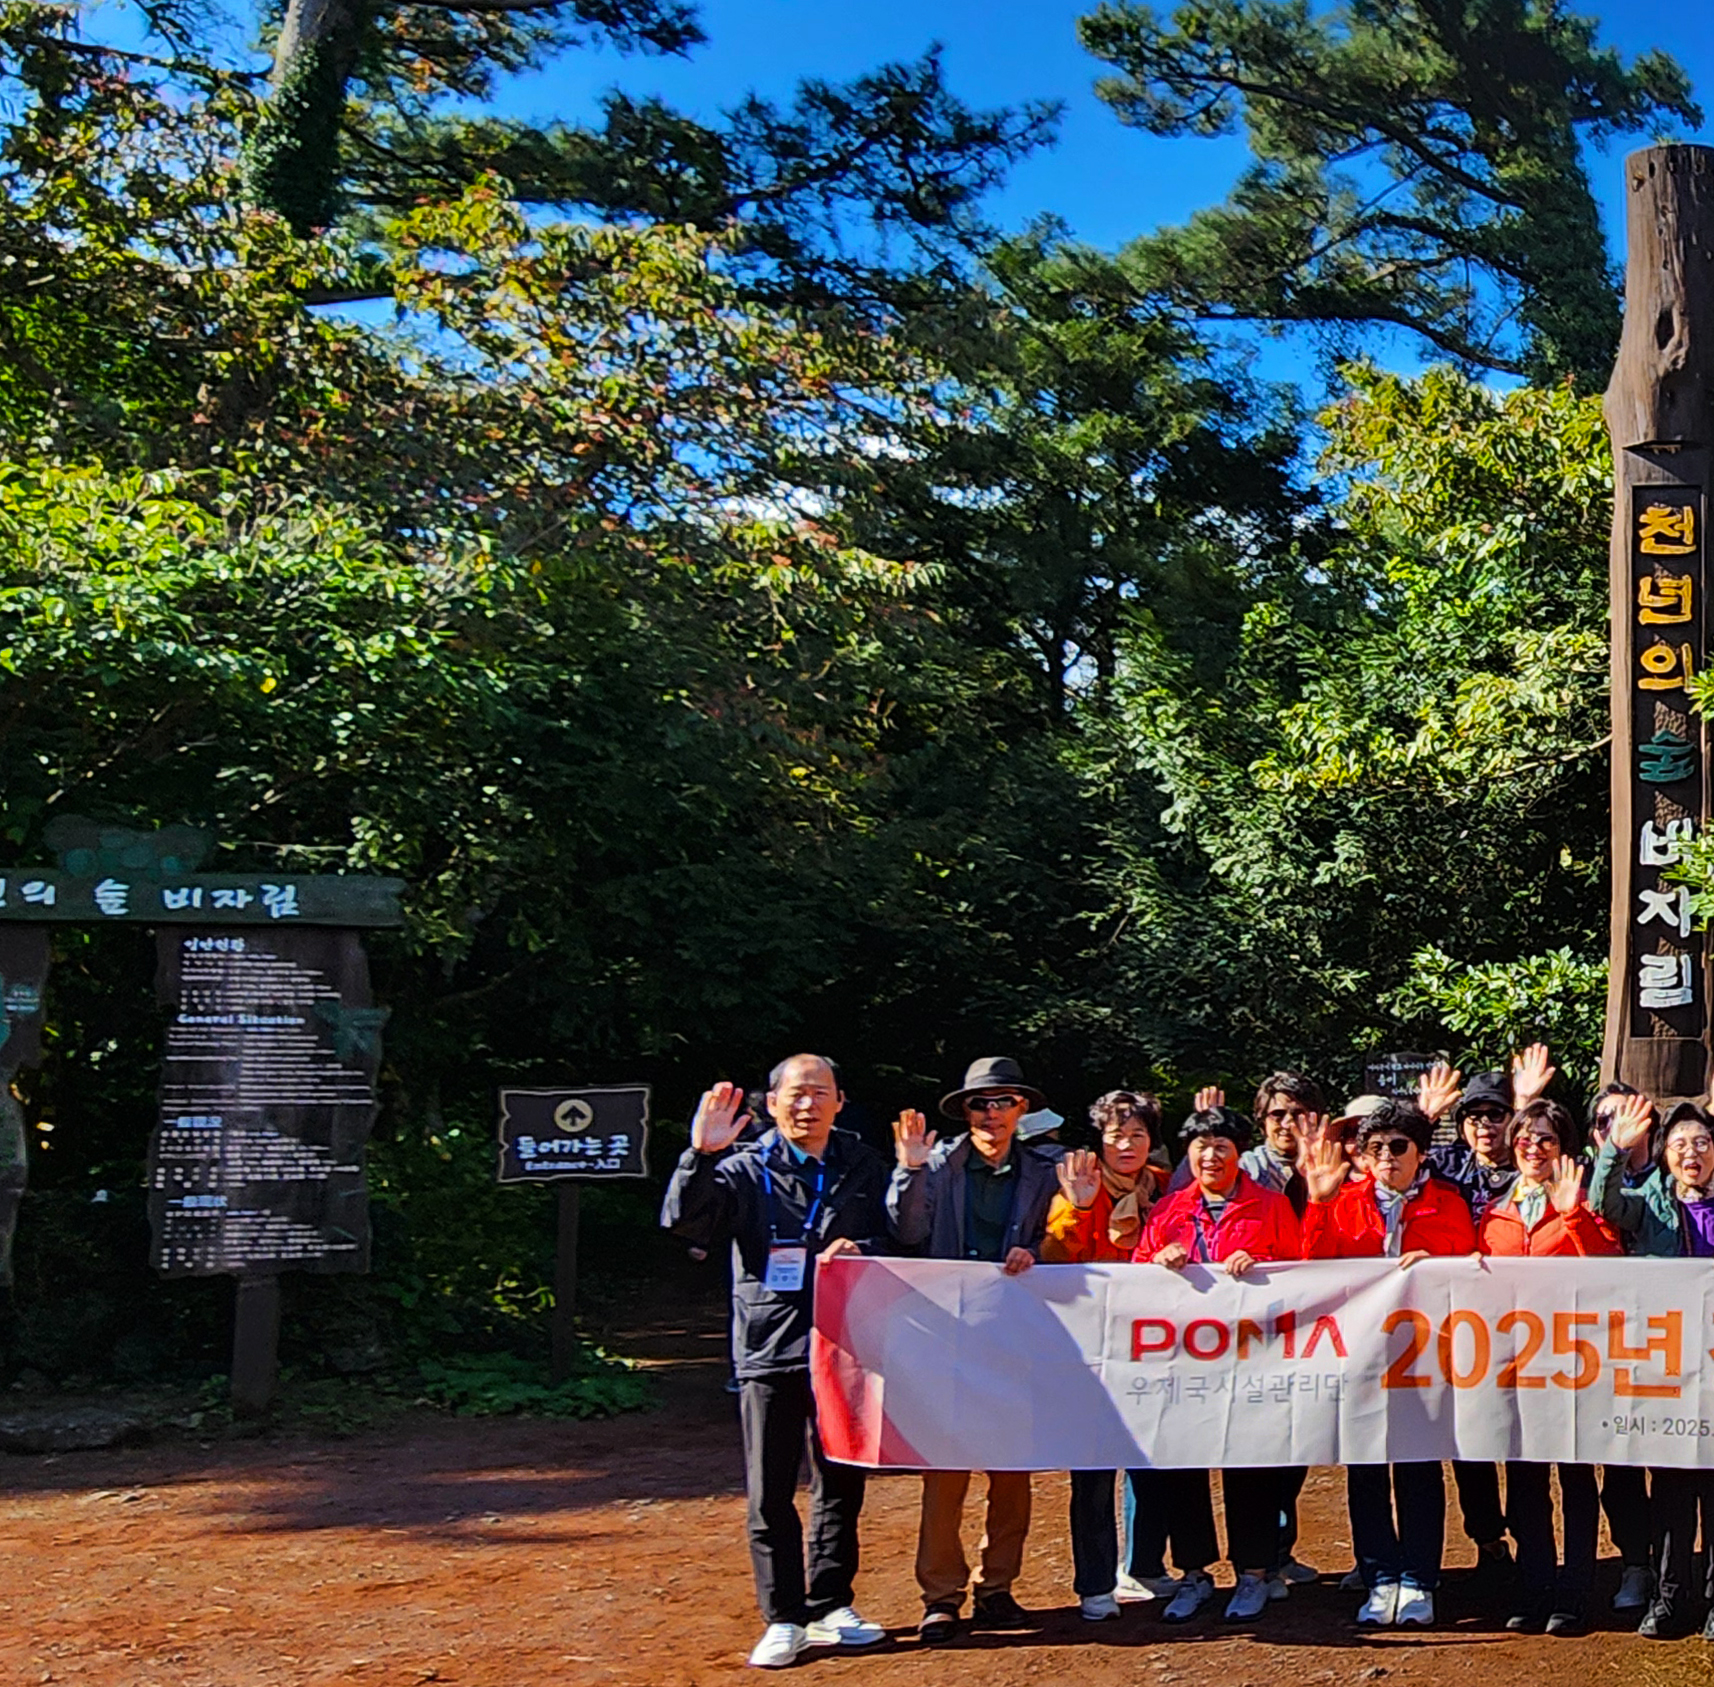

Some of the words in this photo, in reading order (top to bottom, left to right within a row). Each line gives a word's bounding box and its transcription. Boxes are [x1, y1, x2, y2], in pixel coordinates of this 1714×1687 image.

[1638, 505, 1697, 692] 천년의
[1638, 731, 1695, 782] 숲
[163, 884, 299, 918] 비자림
[1637, 817, 1693, 1008] 비자림
[177, 1013, 233, 1024] General
[517, 1135, 603, 1159] 들어가는
[607, 1134, 630, 1156] 곳
[1130, 1308, 1348, 1362] POMA
[1381, 1309, 1682, 1398] 2025년
[1613, 1415, 1645, 1436] 일시
